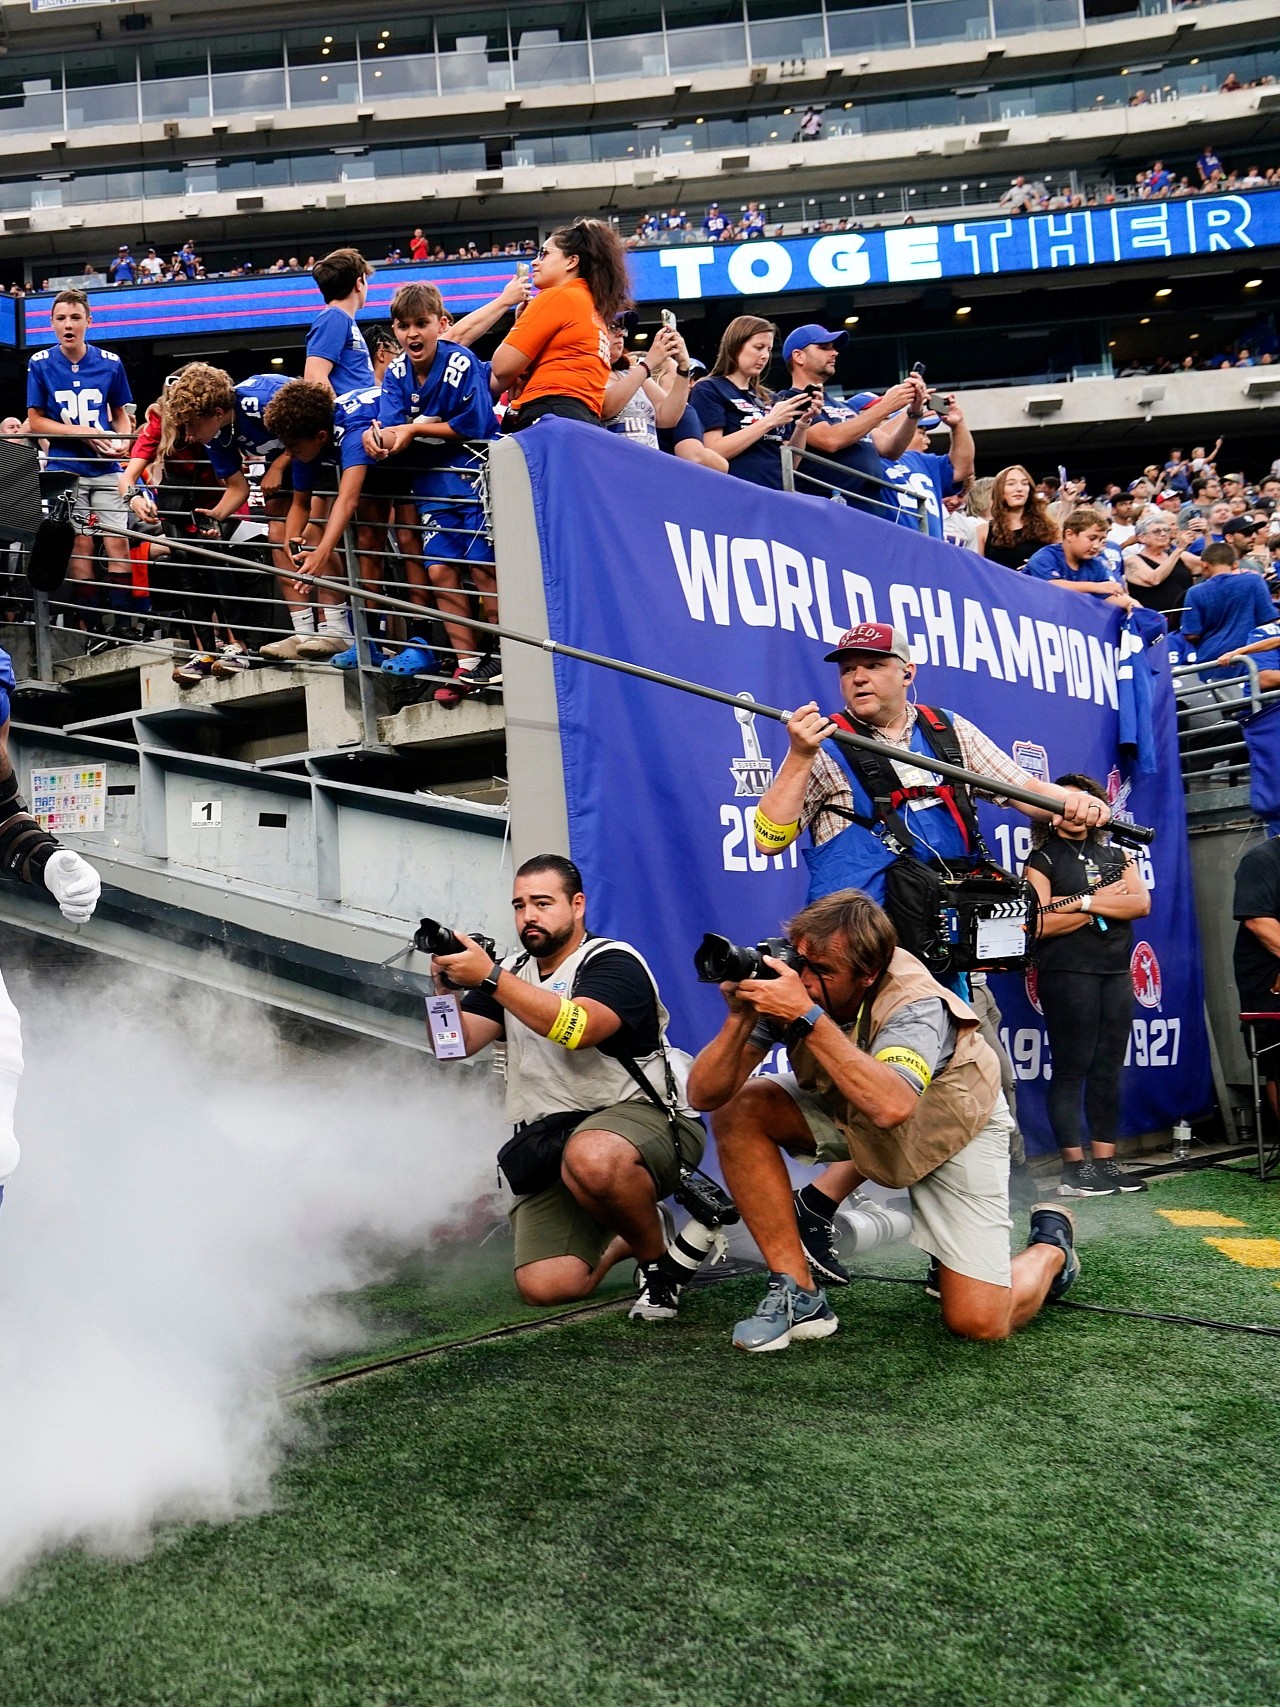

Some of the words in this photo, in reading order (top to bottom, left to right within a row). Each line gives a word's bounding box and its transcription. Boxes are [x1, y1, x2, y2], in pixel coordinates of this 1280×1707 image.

[660, 193, 1255, 300] TOGETHER
[665, 521, 877, 646] WORLD
[888, 584, 1120, 711] CHAMPION
[201, 802, 213, 821] 1
[440, 1013, 449, 1027] 1
